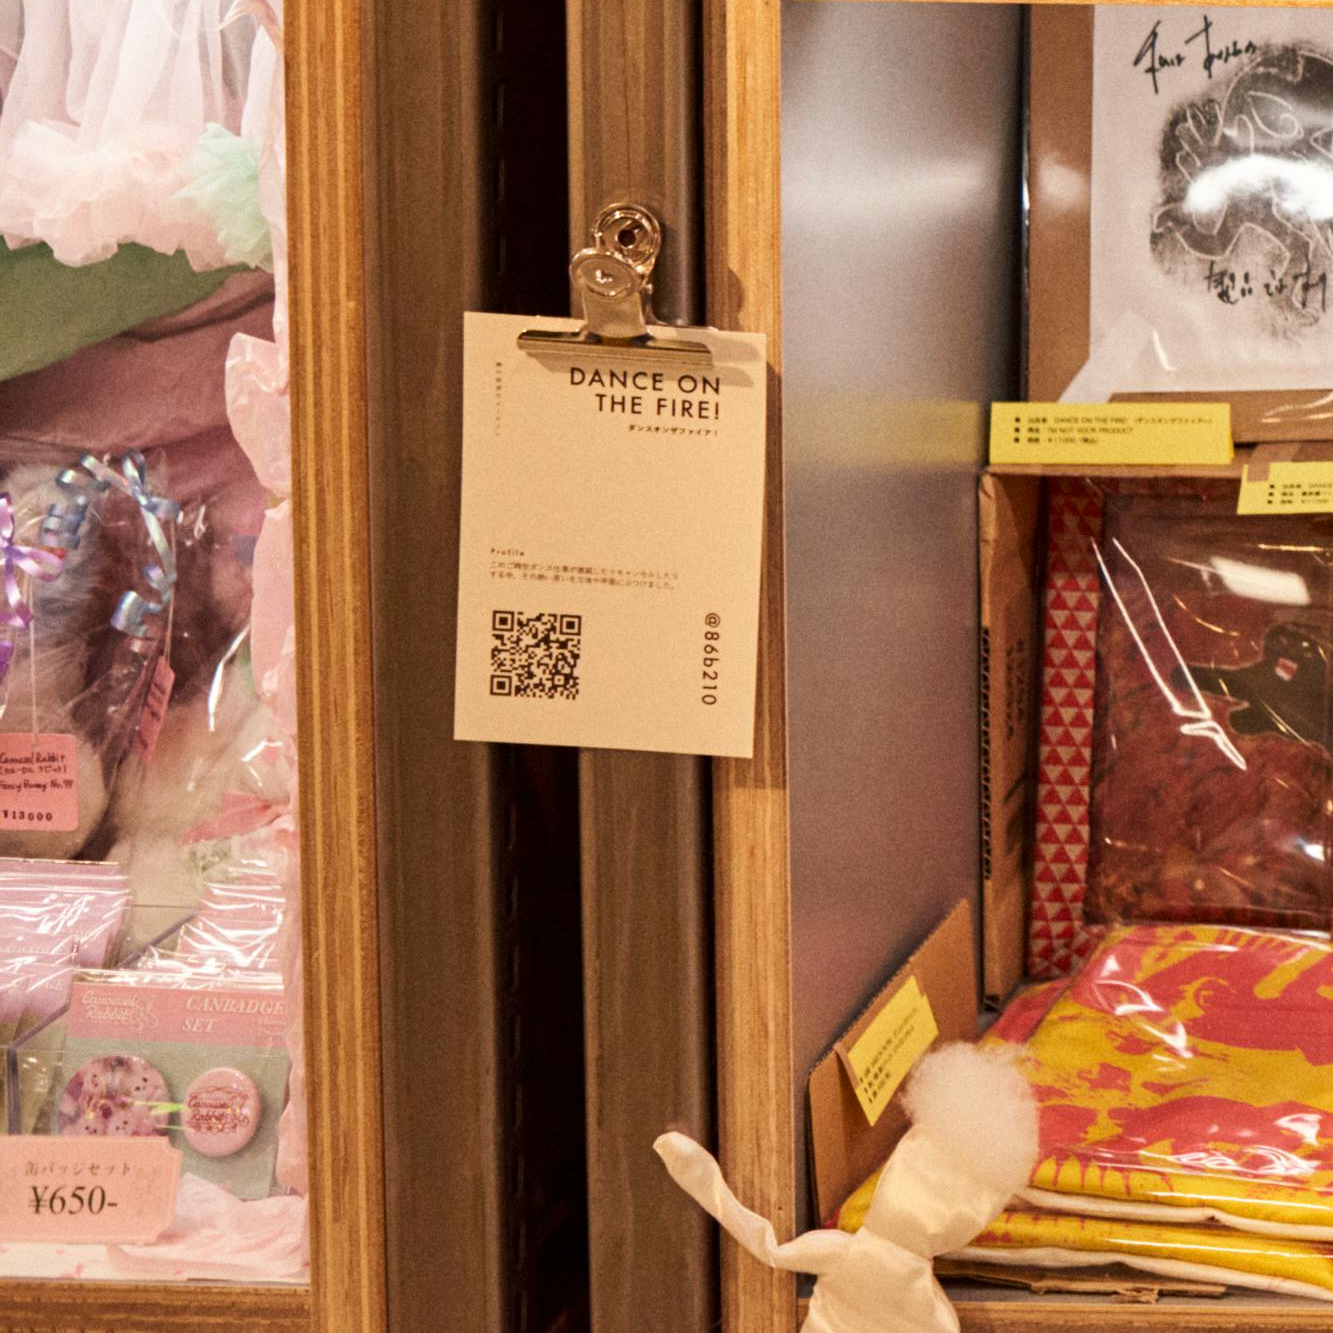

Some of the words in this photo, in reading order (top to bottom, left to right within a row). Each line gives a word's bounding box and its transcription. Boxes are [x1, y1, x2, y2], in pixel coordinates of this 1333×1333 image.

[570, 367, 664, 392] DANCE
[677, 374, 721, 395] ON
[595, 393, 643, 415] THE
[656, 397, 721, 421] FIRE!
[186, 997, 285, 1015] CANBADGE
[182, 1017, 219, 1033] SET
[28, 1185, 118, 1215] ¥650-
